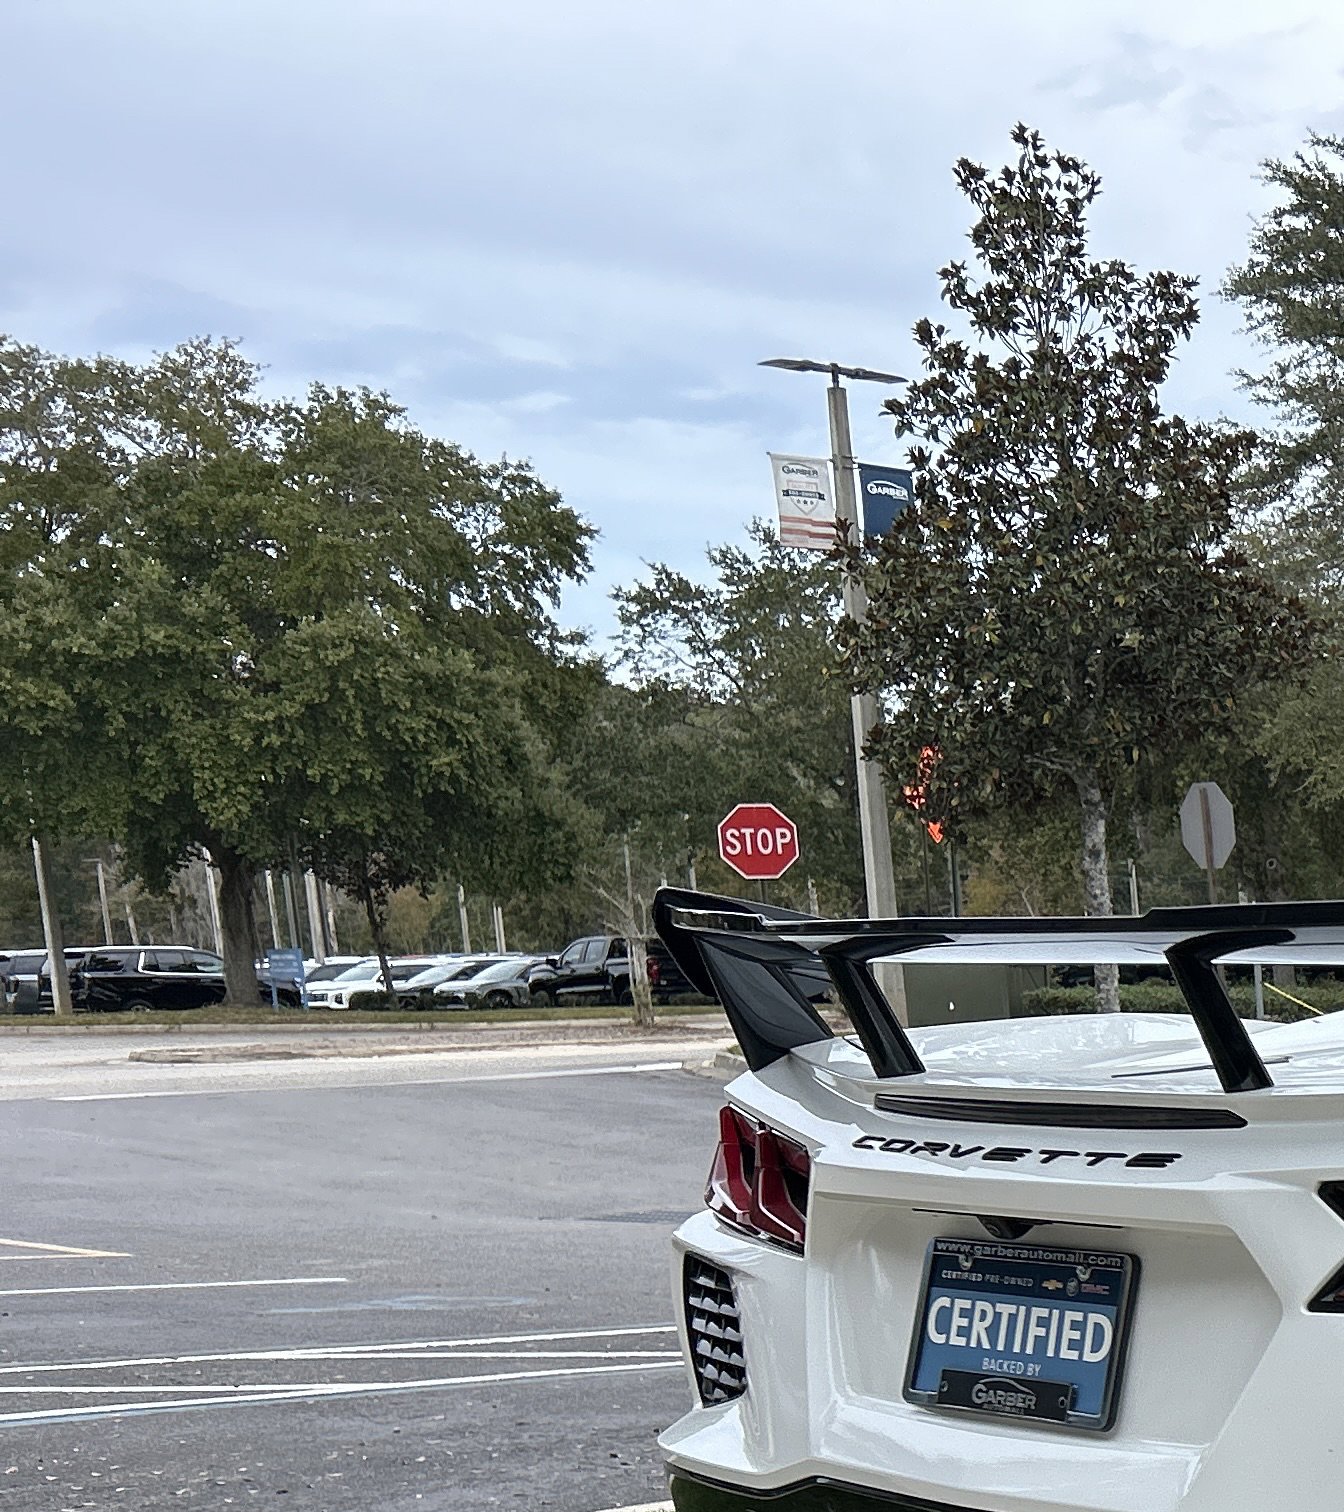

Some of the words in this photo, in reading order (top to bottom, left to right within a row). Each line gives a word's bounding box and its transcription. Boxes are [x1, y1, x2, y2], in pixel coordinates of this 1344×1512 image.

[725, 828, 792, 856] STOP
[852, 1135, 1183, 1169] CORVETTE
[936, 1241, 1121, 1267] www.garberautomall.com
[927, 1296, 1114, 1363] CERTIFIED
[982, 1357, 1025, 1374] BACKED
[1026, 1363, 1041, 1376] BY
[971, 1383, 1037, 1410] GARBER
